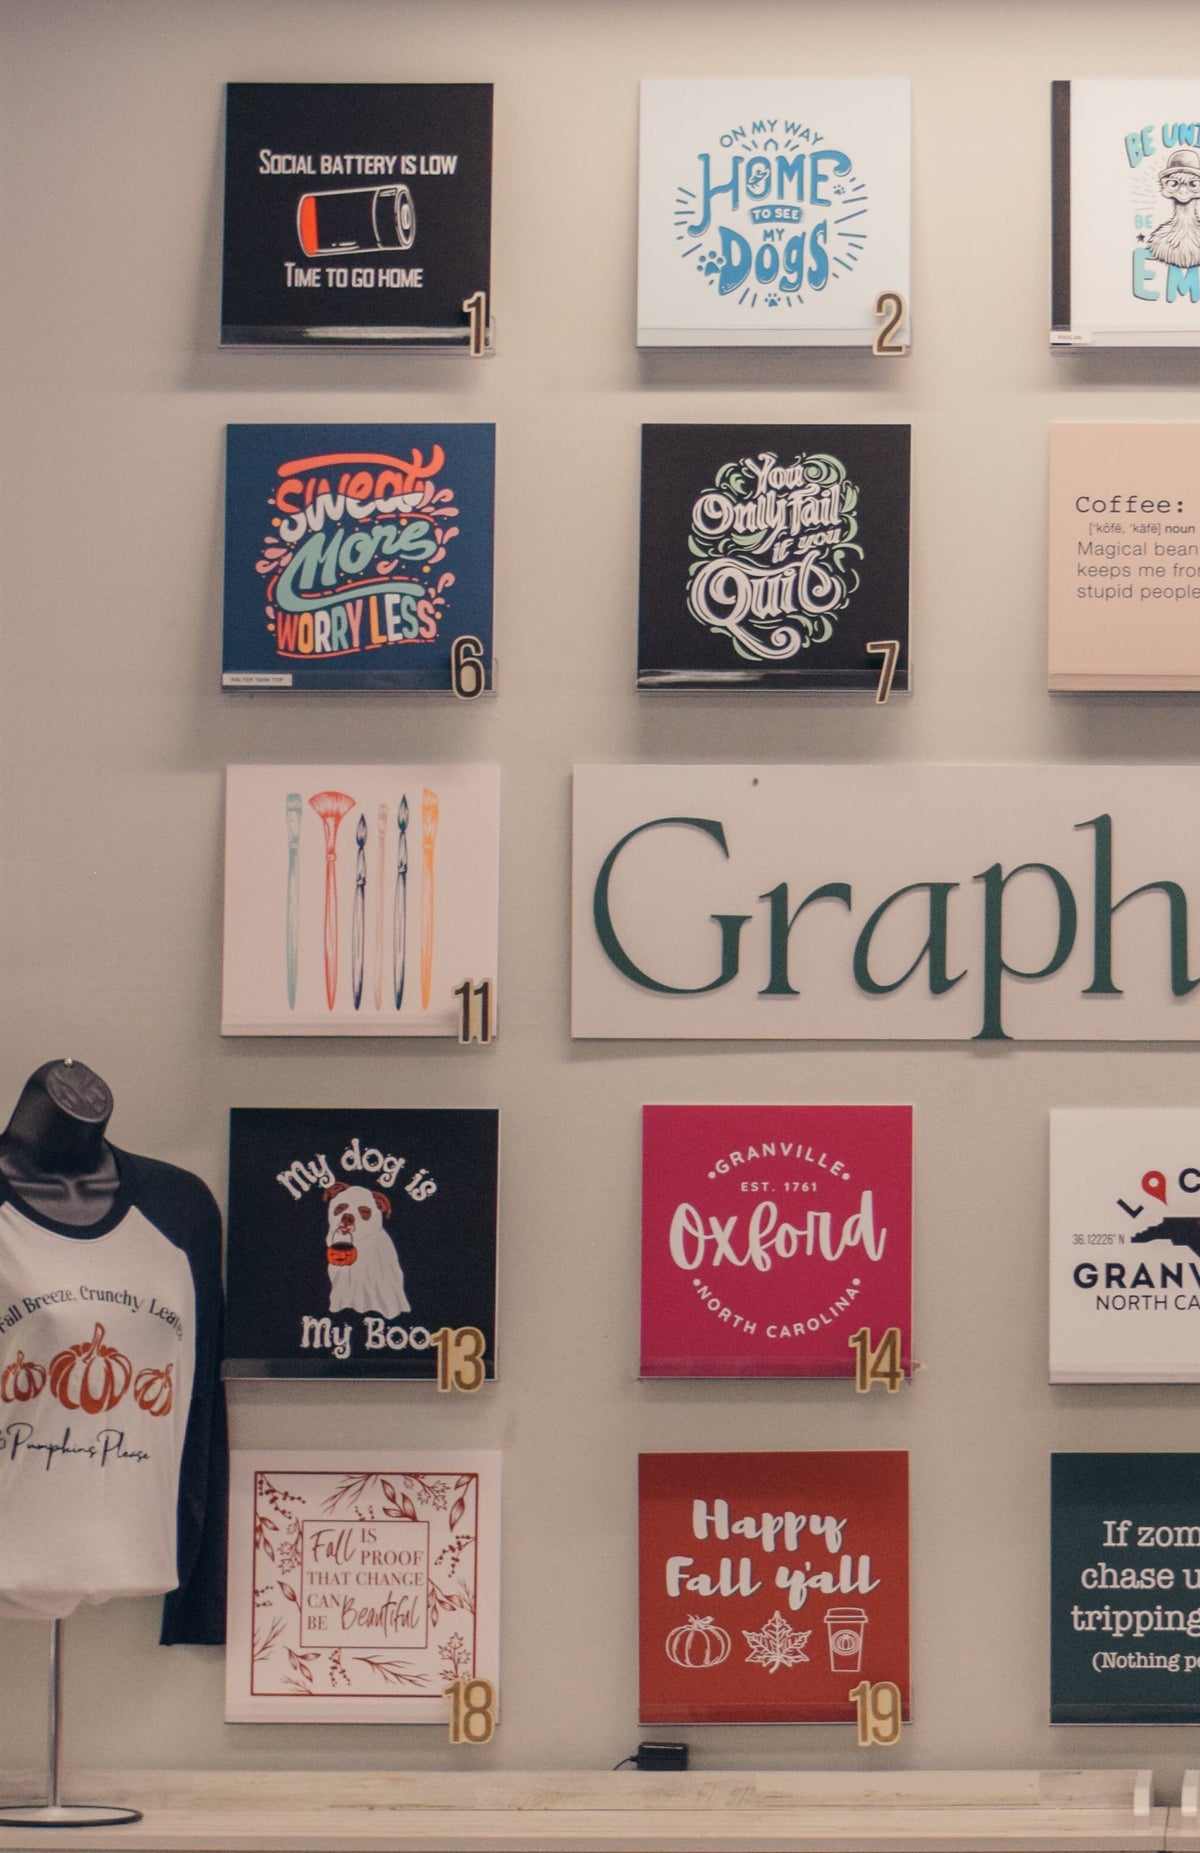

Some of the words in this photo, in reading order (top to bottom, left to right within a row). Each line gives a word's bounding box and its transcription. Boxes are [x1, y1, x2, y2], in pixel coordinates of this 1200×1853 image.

[720, 126, 746, 147] ON
[751, 120, 778, 134] MY
[784, 121, 824, 145] WAY
[1125, 125, 1155, 168] BE
[259, 149, 316, 175] SOCIAL
[321, 155, 397, 175] BATTERY
[401, 155, 416, 175] IS
[420, 155, 457, 175] LOW
[688, 150, 851, 237] HOME
[753, 209, 770, 220] TO
[774, 208, 799, 220] SEE
[763, 229, 784, 241] MY
[1135, 215, 1152, 229] BE
[284, 262, 321, 288] TIME
[326, 268, 347, 288] TO
[352, 268, 374, 288] GO
[378, 268, 423, 288] HOME
[463, 291, 485, 356] 1
[873, 291, 906, 355] 2
[276, 444, 445, 542] Sweat
[740, 452, 804, 498] You
[692, 492, 787, 553] Only
[1075, 496, 1183, 513] Coffee:
[772, 539, 794, 563] if
[798, 528, 841, 554] you
[1078, 542, 1147, 559] Magical
[1154, 542, 1198, 556] bean
[1165, 524, 1195, 534] noun
[1078, 563, 1131, 577] keeps
[1138, 566, 1166, 577] me
[690, 551, 842, 659] Quit
[1077, 584, 1132, 601] stupid
[277, 599, 363, 653] WORRY
[369, 594, 437, 643] LESS
[451, 635, 484, 700] 6
[866, 641, 900, 703] 7
[454, 978, 491, 1044] 11
[277, 1154, 336, 1200] My
[340, 1138, 405, 1188] dog
[405, 1169, 437, 1201] is
[715, 1142, 844, 1175] GRANVILLE
[741, 1182, 775, 1191] EST.
[784, 1182, 817, 1191] 1761
[669, 1190, 886, 1272] Oxford
[697, 1286, 757, 1334] NORTH
[766, 1287, 859, 1338] CAROLINA
[1096, 1295, 1167, 1310] NORTH
[300, 1316, 352, 1359] My
[364, 1317, 432, 1349] Boo
[430, 1326, 486, 1392] 13
[848, 1326, 904, 1393] 14
[6, 1422, 97, 1471] Pumpkins
[97, 1428, 151, 1467] Please
[309, 1529, 357, 1564] Fall
[360, 1528, 377, 1543] IS
[692, 1499, 847, 1553] Happy
[1102, 1520, 1132, 1547] If
[307, 1572, 349, 1585] THAT
[356, 1572, 424, 1585] CHANGE
[360, 1551, 424, 1565] PROOF
[1081, 1562, 1175, 1589] chase
[665, 1555, 762, 1597] Fall
[775, 1554, 881, 1611] y'all
[307, 1594, 339, 1608] CAN
[341, 1591, 422, 1637] Beautiful
[307, 1615, 327, 1630] BE
[1092, 1652, 1181, 1672] (Nothing
[442, 1678, 495, 1744] 18
[849, 1680, 901, 1746] 19
